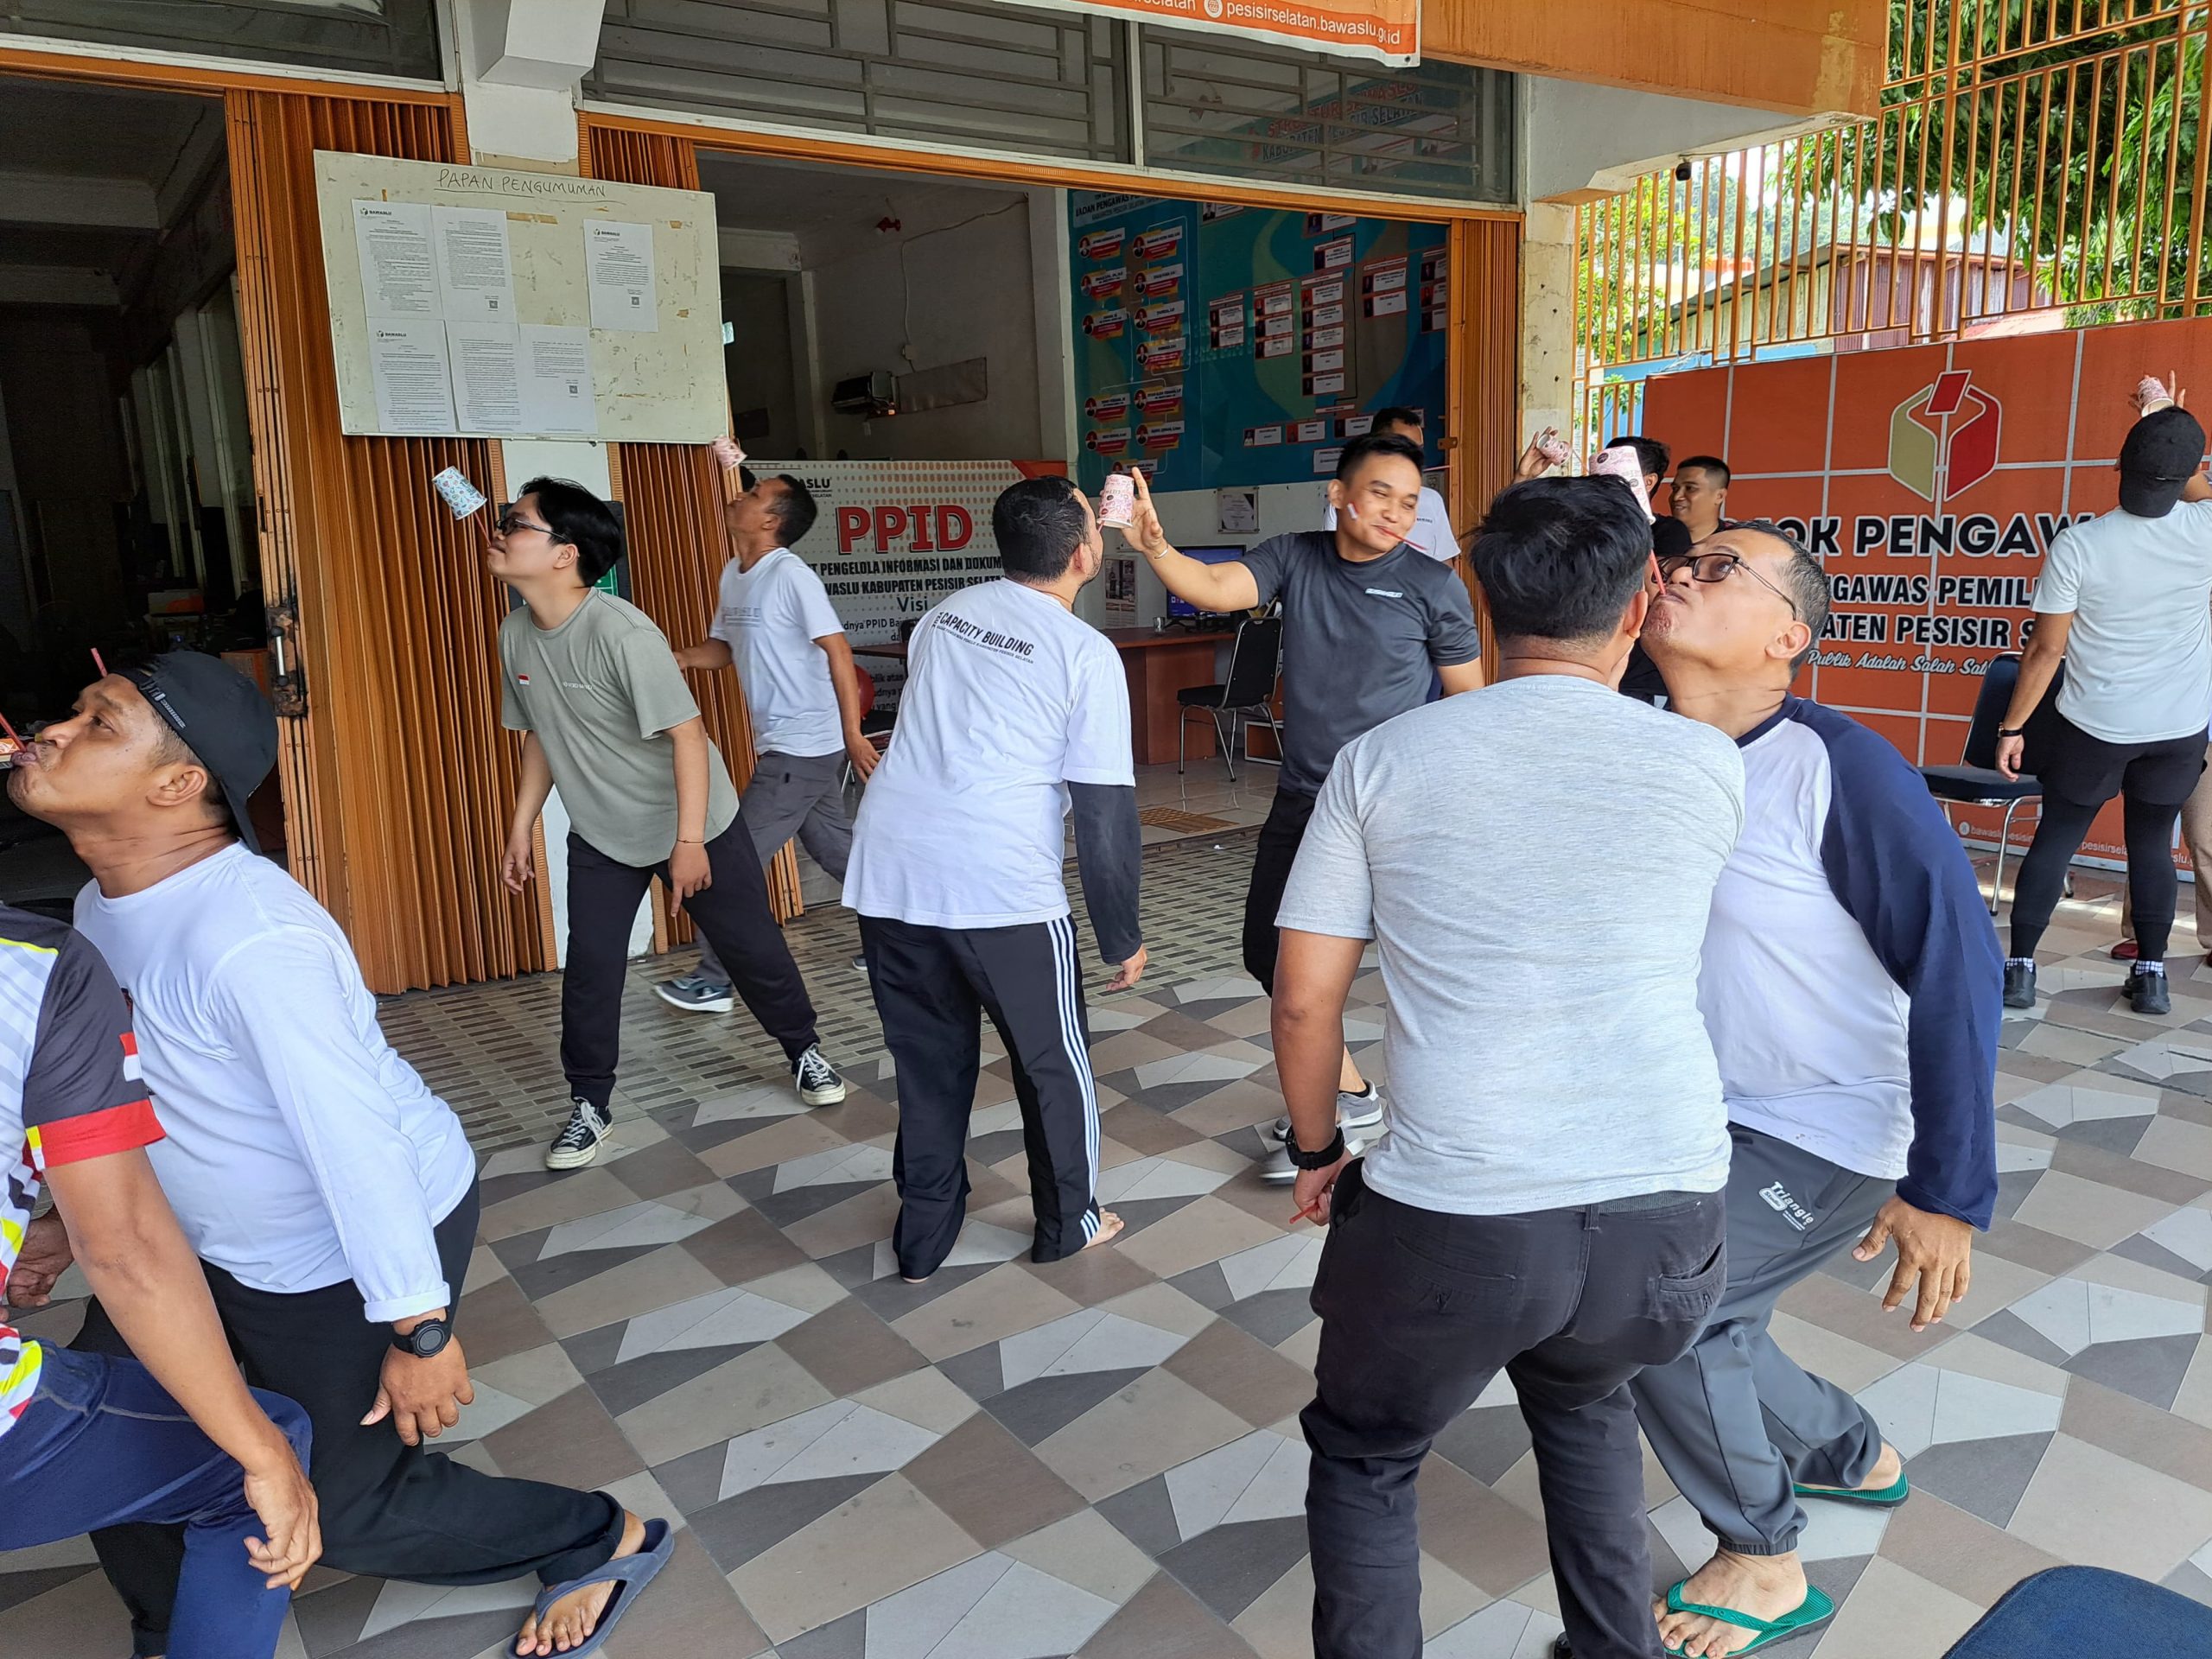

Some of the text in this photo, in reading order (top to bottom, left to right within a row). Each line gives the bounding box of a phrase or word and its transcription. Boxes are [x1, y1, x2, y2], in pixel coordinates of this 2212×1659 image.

[437, 168, 606, 197] PAPAN PENGUMUMAN
[836, 505, 973, 555] PPID
[821, 561, 880, 576] PENGELOLA
[882, 558, 940, 573] INFORMASI
[942, 557, 963, 571] DAN
[861, 578, 923, 594] KABUPATEN
[925, 576, 965, 591] PESISIR
[1827, 575, 2040, 607] GAWAS PEMIL
[897, 596, 928, 612] Visi
[866, 619, 887, 629] PPID
[939, 612, 983, 639] CAPACITY
[982, 631, 1034, 656] BUILDING
[1896, 615, 2011, 648] PESISIR
[1808, 649, 1853, 668] Publik
[1854, 652, 1907, 672] Adalah
[1910, 656, 1955, 674] Salah
[1770, 1181, 1814, 1224] Triangle
